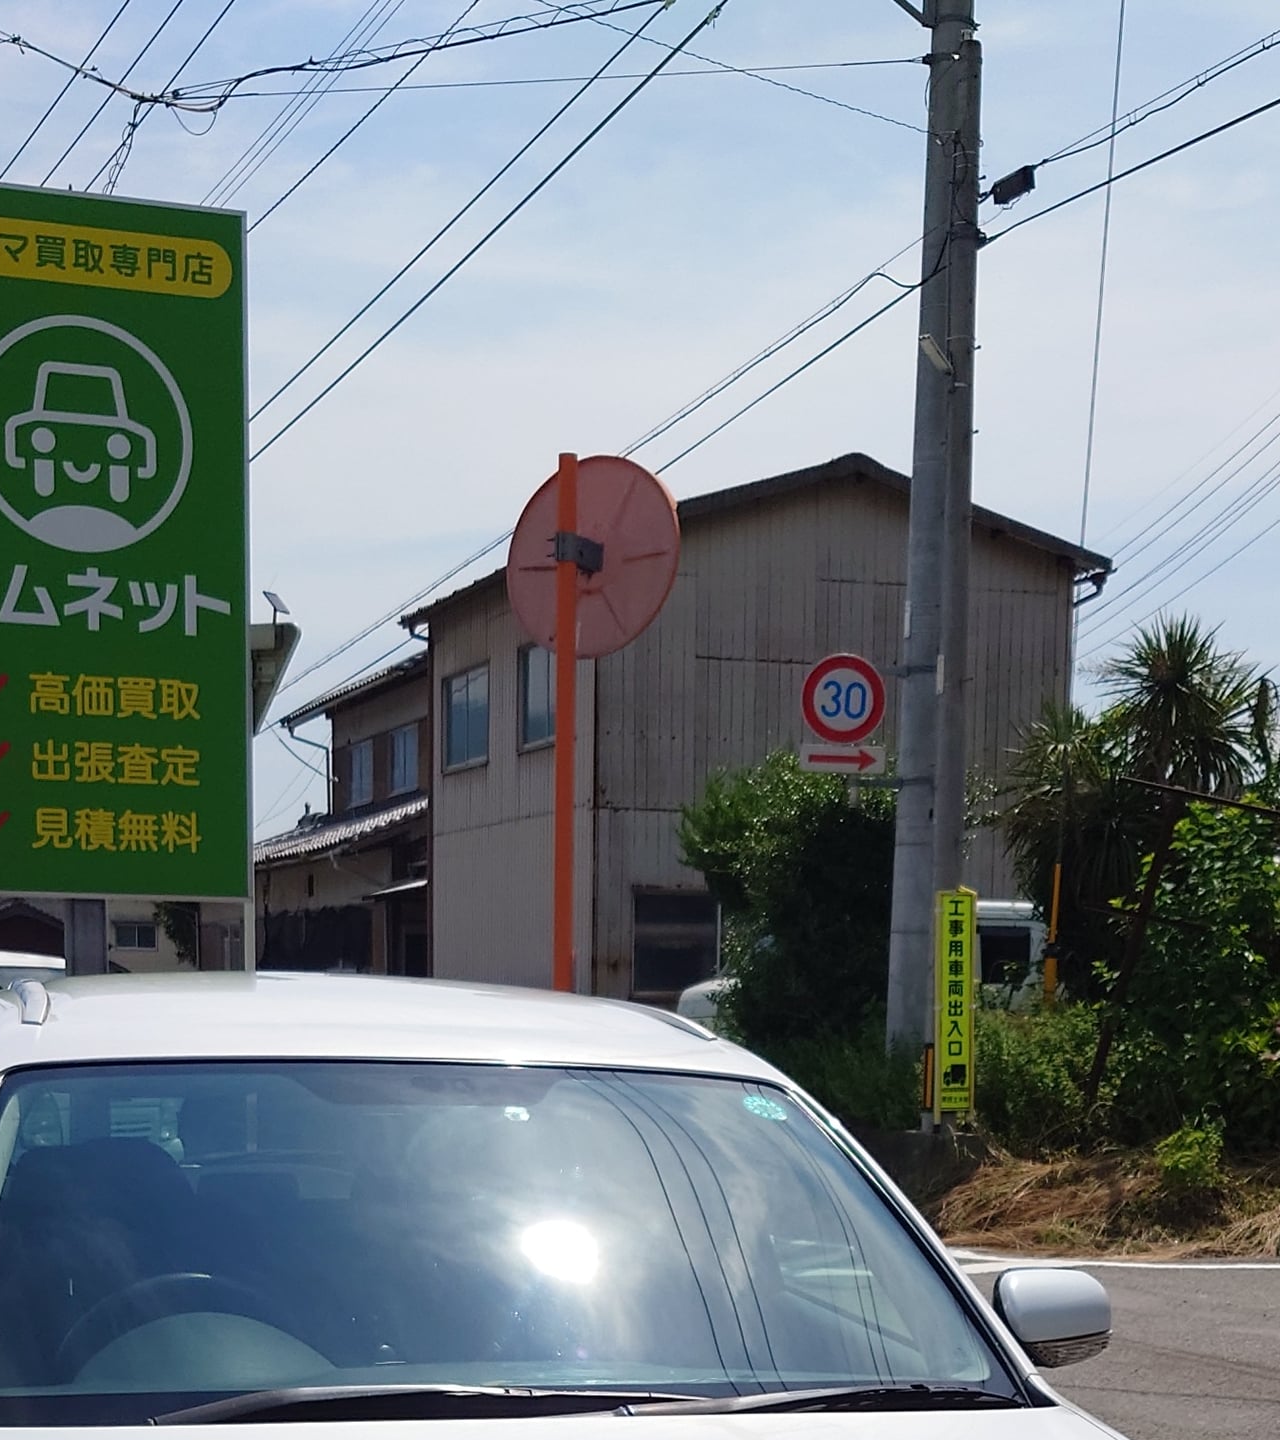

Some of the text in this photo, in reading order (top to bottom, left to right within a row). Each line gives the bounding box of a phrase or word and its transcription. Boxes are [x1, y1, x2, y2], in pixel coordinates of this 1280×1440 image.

[28, 672, 201, 721] 高価買取
[821, 680, 867, 720] 30
[31, 741, 201, 787] 出張査定
[31, 808, 202, 854] 見積無料
[947, 899, 965, 1057] 工事用車両出入口
